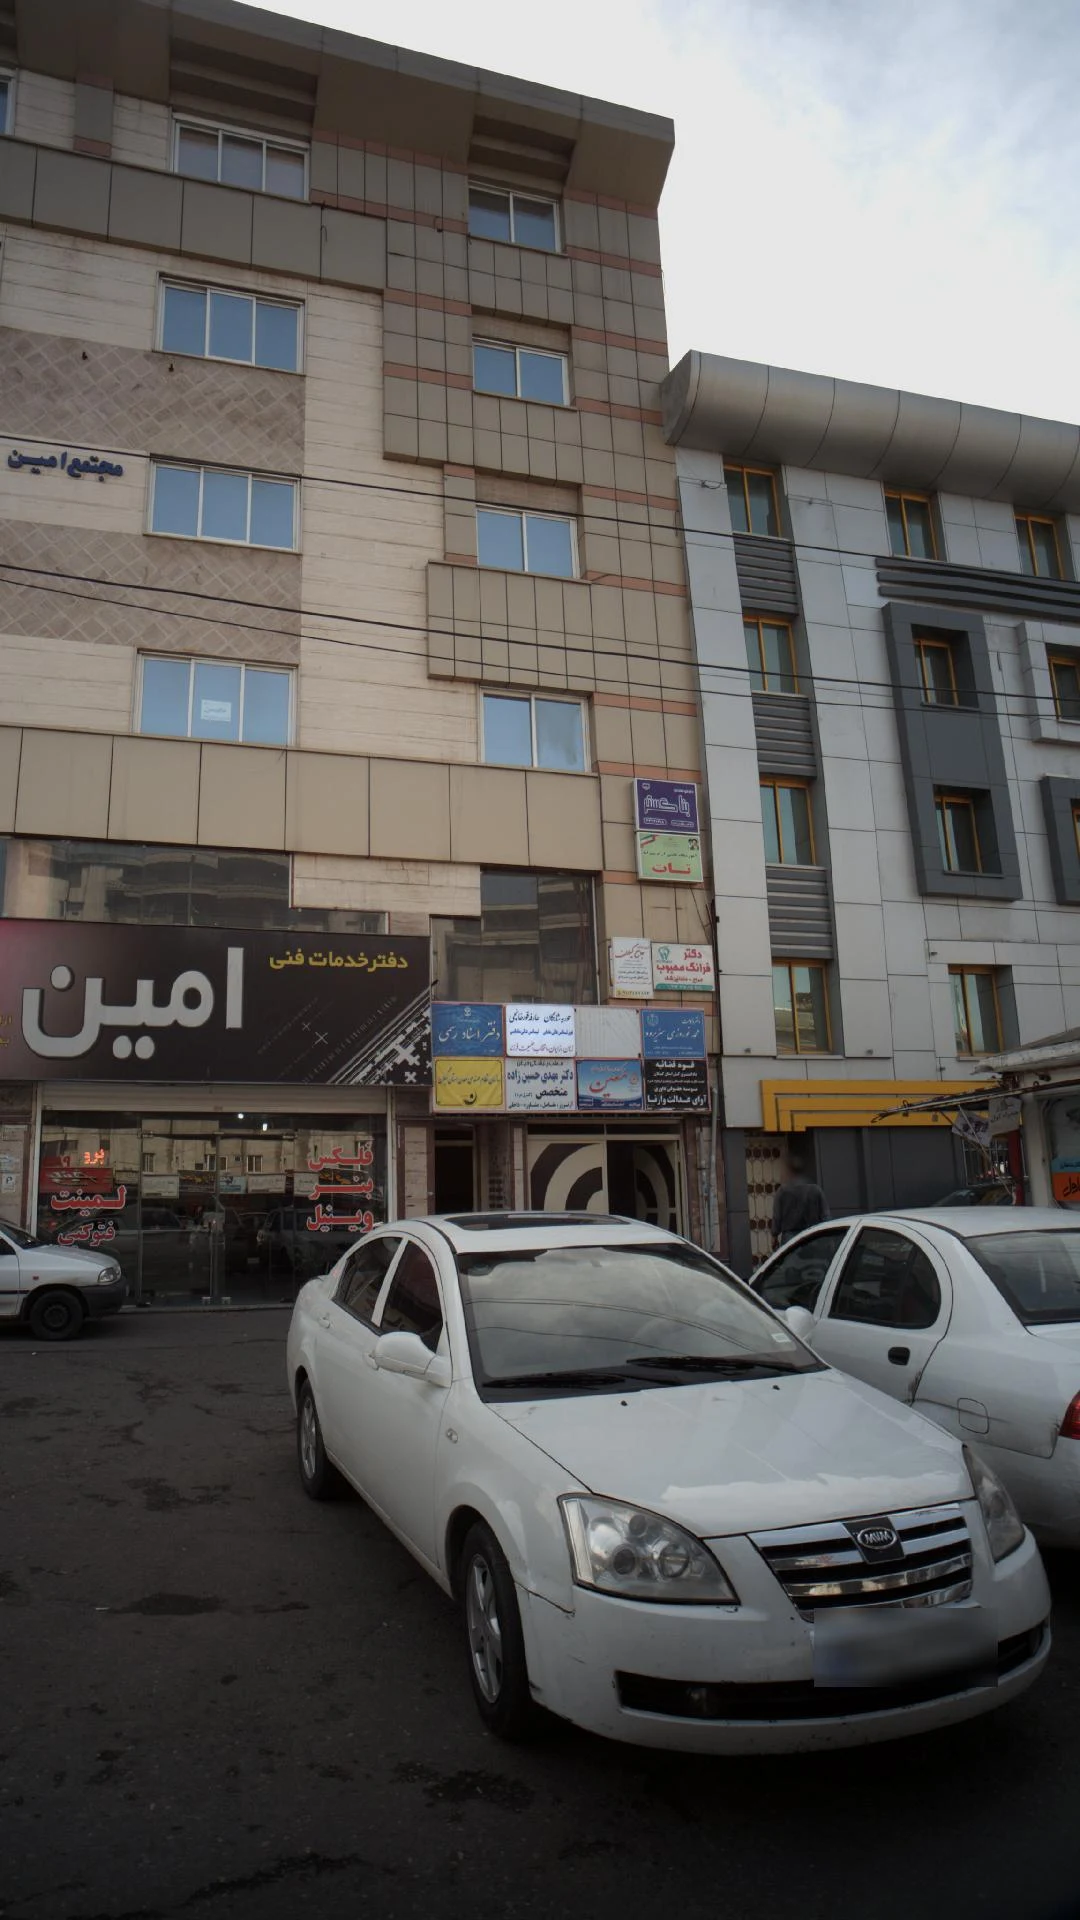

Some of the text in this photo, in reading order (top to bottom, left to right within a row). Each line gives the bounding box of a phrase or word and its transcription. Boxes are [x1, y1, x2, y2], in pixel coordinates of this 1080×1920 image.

[8, 449, 124, 481] مجتمع امین
[652, 861, 691, 874] تات
[269, 948, 409, 973] دفتر خدمات فنی
[684, 948, 702, 961] دکتر
[656, 964, 685, 974] محبوب
[22, 946, 244, 1058] امین
[438, 1025, 459, 1043] رسمی
[462, 1026, 480, 1040] اسناد
[480, 1020, 501, 1043] دفتر
[522, 1071, 541, 1084] حسین
[541, 1071, 558, 1083] مهدی
[560, 1069, 573, 1084] دکتر
[535, 1086, 568, 1100] متخصص
[308, 1142, 374, 1171] فلکس
[307, 1176, 374, 1200] بنر
[51, 1184, 127, 1217] لمینت
[306, 1204, 375, 1233] وینیل
